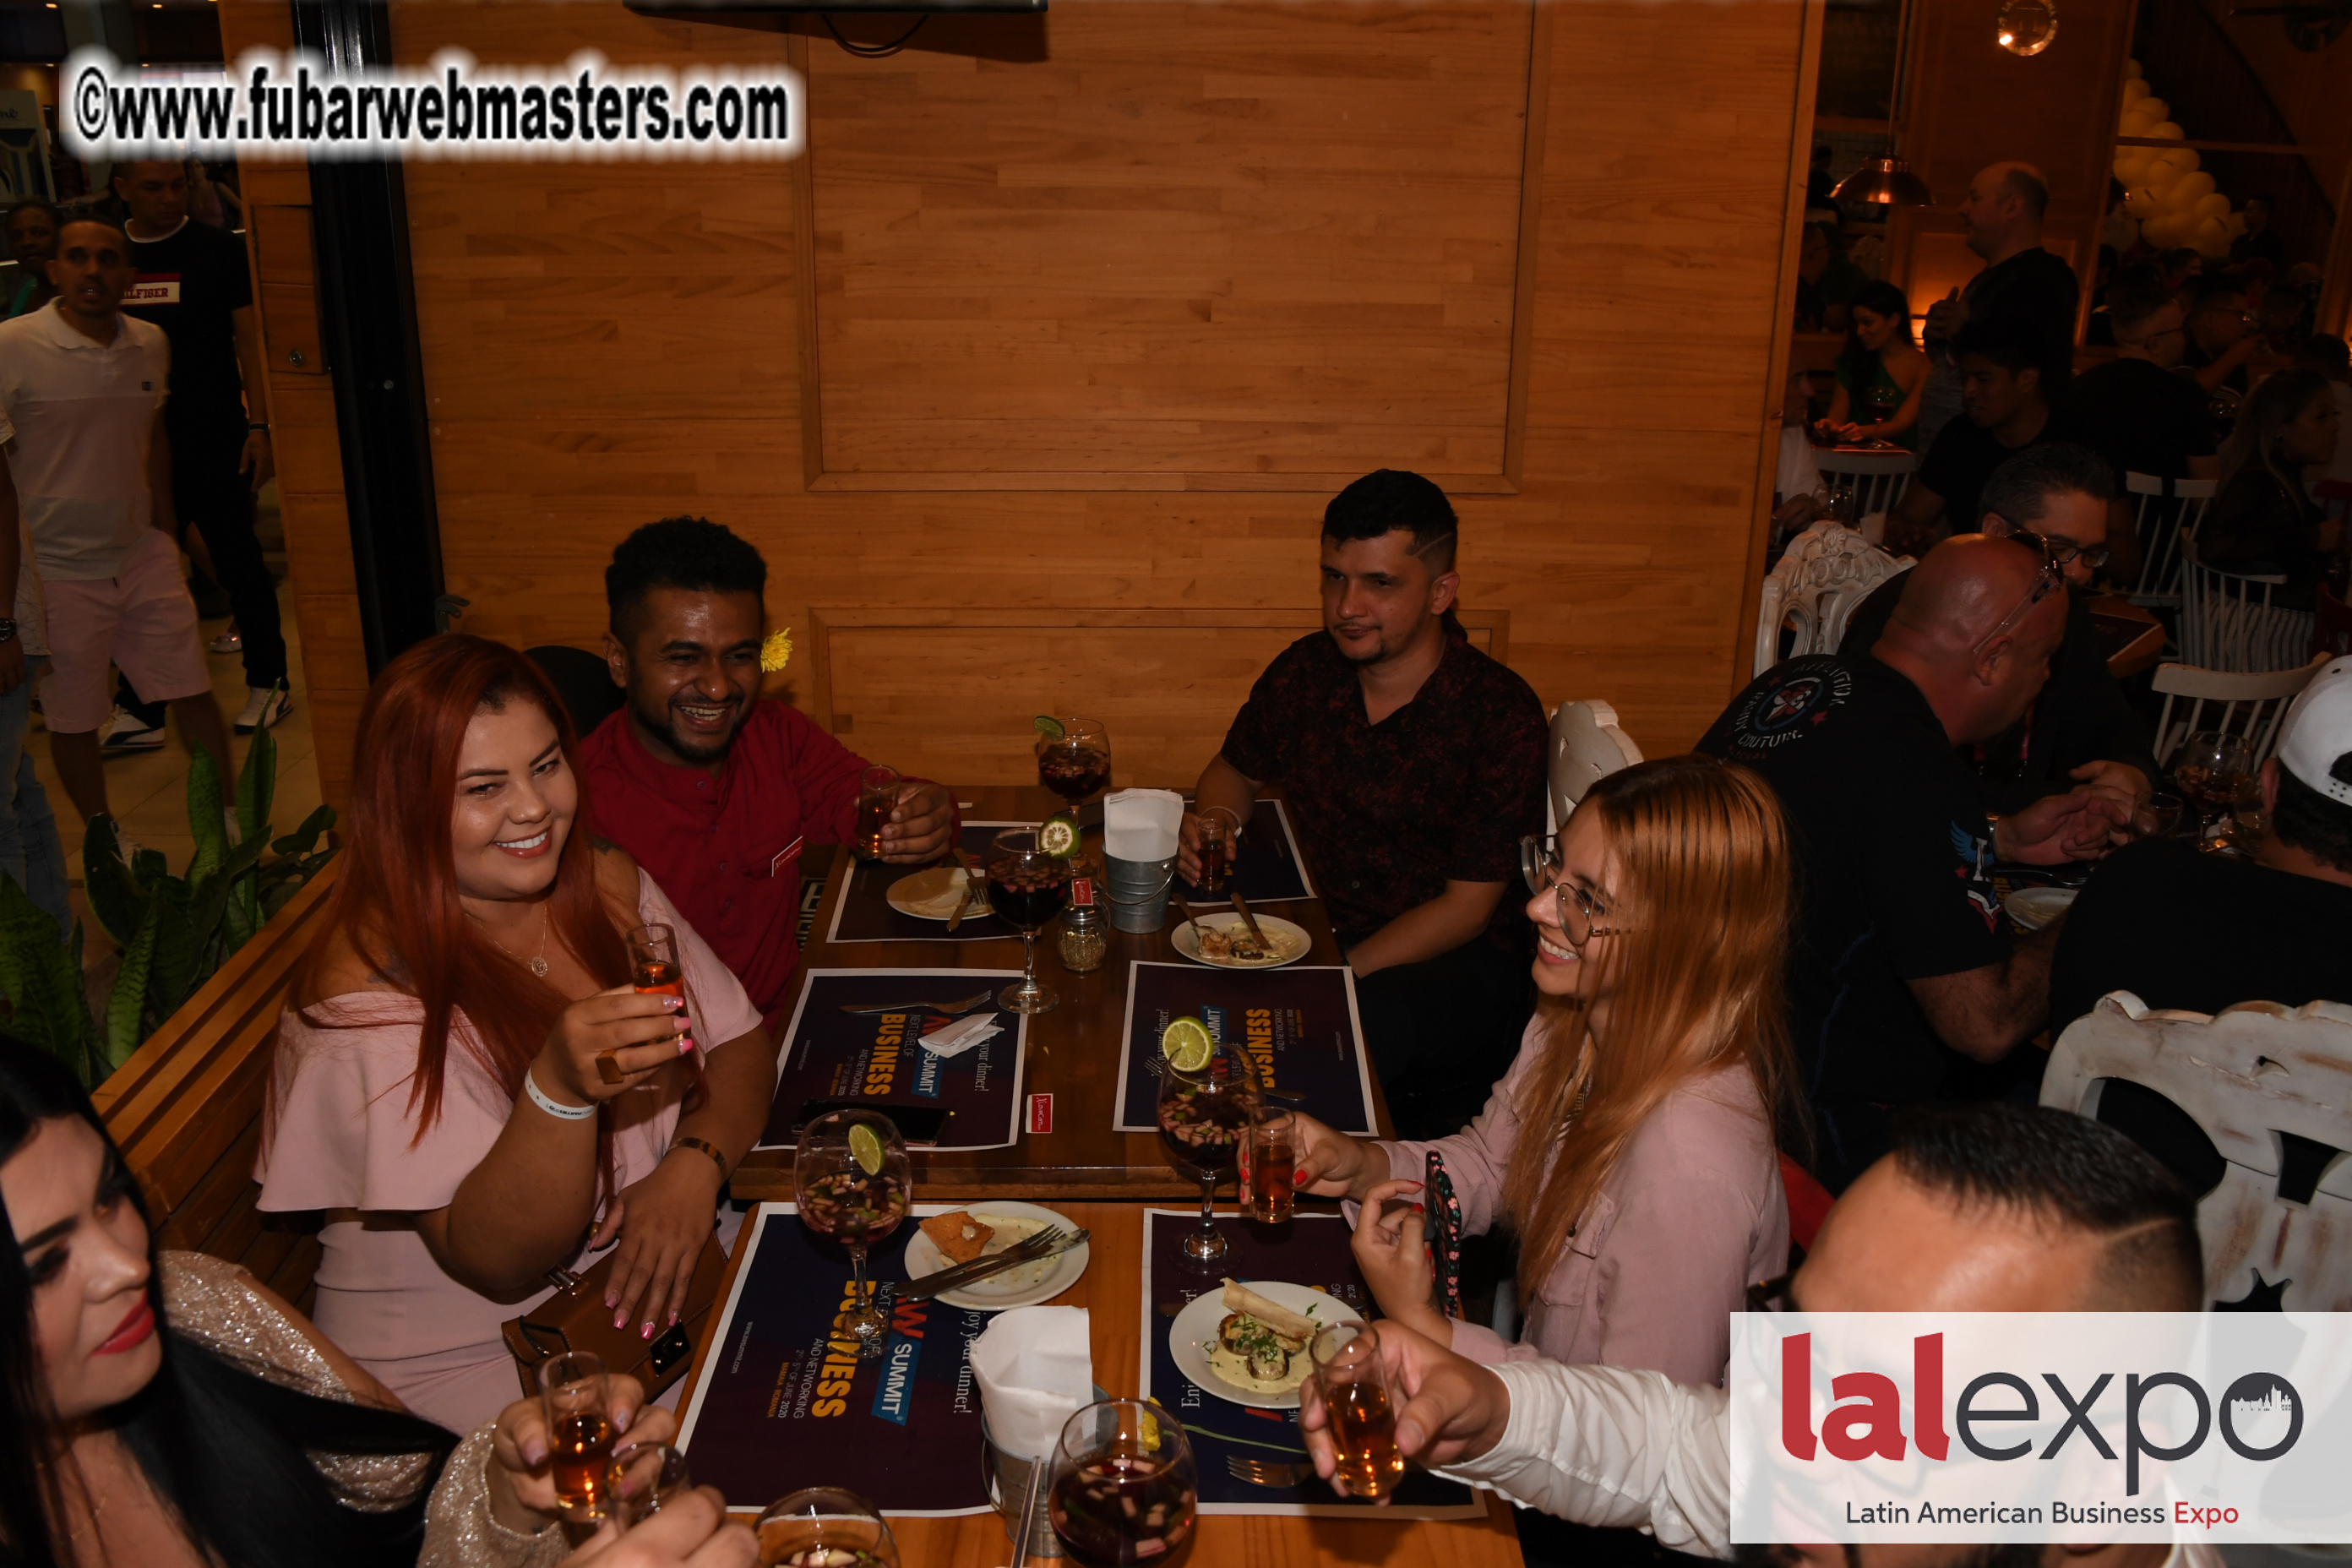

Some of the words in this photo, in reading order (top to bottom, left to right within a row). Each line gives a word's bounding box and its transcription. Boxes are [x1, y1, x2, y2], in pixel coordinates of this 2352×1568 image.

[122, 287, 168, 299] ILFIGER
[863, 1014, 906, 1095] BUSINESS
[918, 1051, 939, 1093] SUMMIT
[974, 1062, 993, 1092] dinner!
[878, 1282, 896, 1306] NEXT
[810, 1337, 825, 1357] AND
[792, 1357, 819, 1419] NETWORKING
[881, 1343, 912, 1415] SUMMIT
[777, 1401, 791, 1418] 2020
